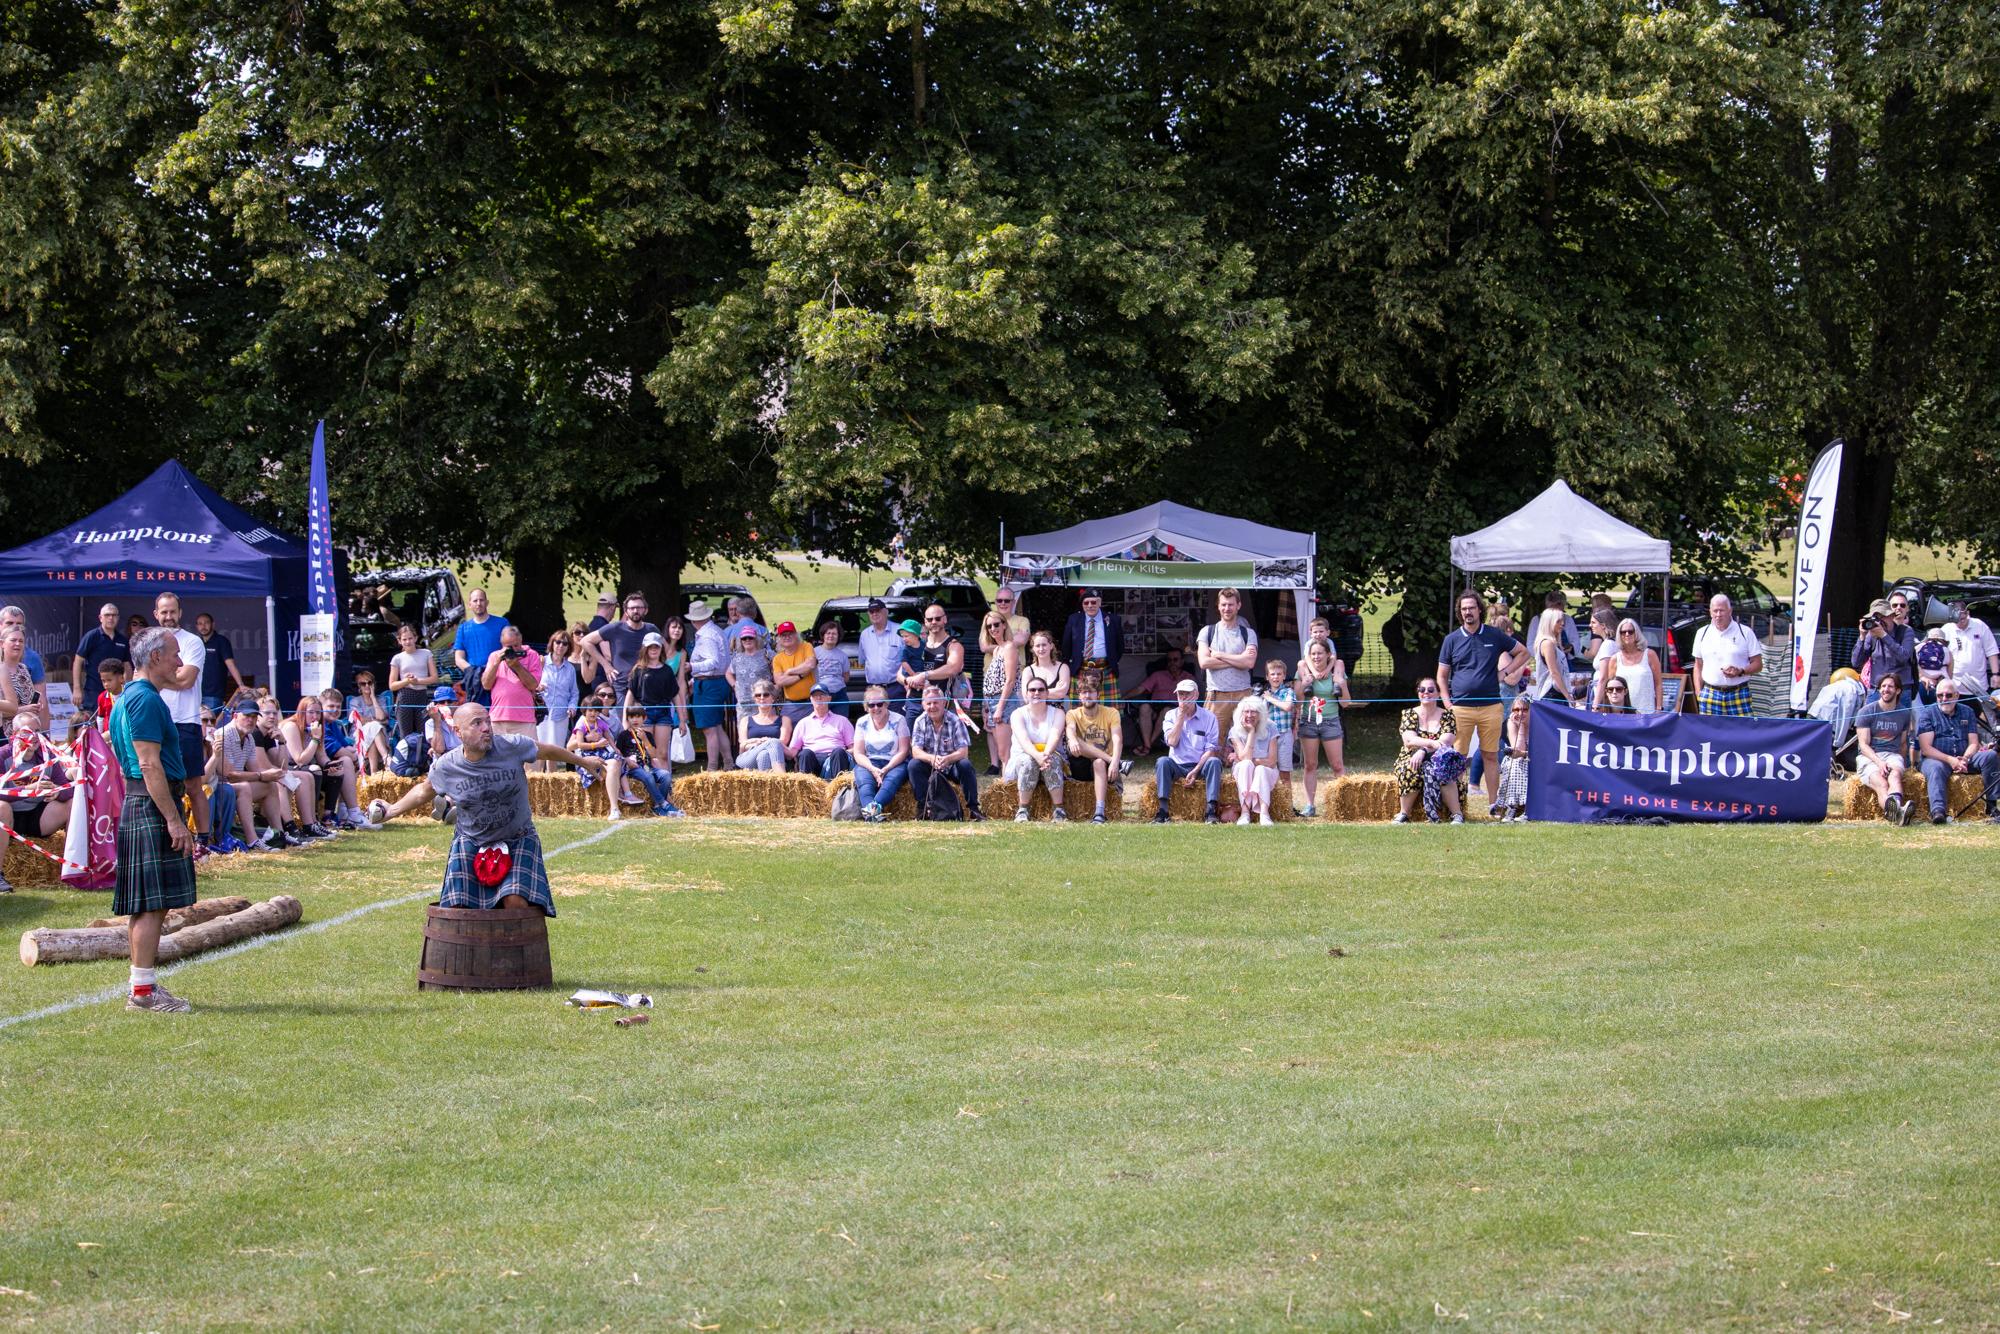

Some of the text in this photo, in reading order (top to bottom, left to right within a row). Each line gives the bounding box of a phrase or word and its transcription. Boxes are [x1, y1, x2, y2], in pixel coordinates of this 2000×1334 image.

[72, 526, 213, 544] Hamptons
[1097, 561, 1135, 574] Henry
[1140, 564, 1167, 575] Kilts
[1797, 496, 1824, 622] LIVE ON
[47, 571, 207, 581] THE HOME EXPERTS
[1212, 578, 1249, 586] Contemporary
[1555, 727, 1802, 786] Hamptons
[455, 768, 517, 795] SUPERDRY
[1575, 790, 1778, 816] THE HOME EXPERTS
[480, 810, 507, 824] WORLD
